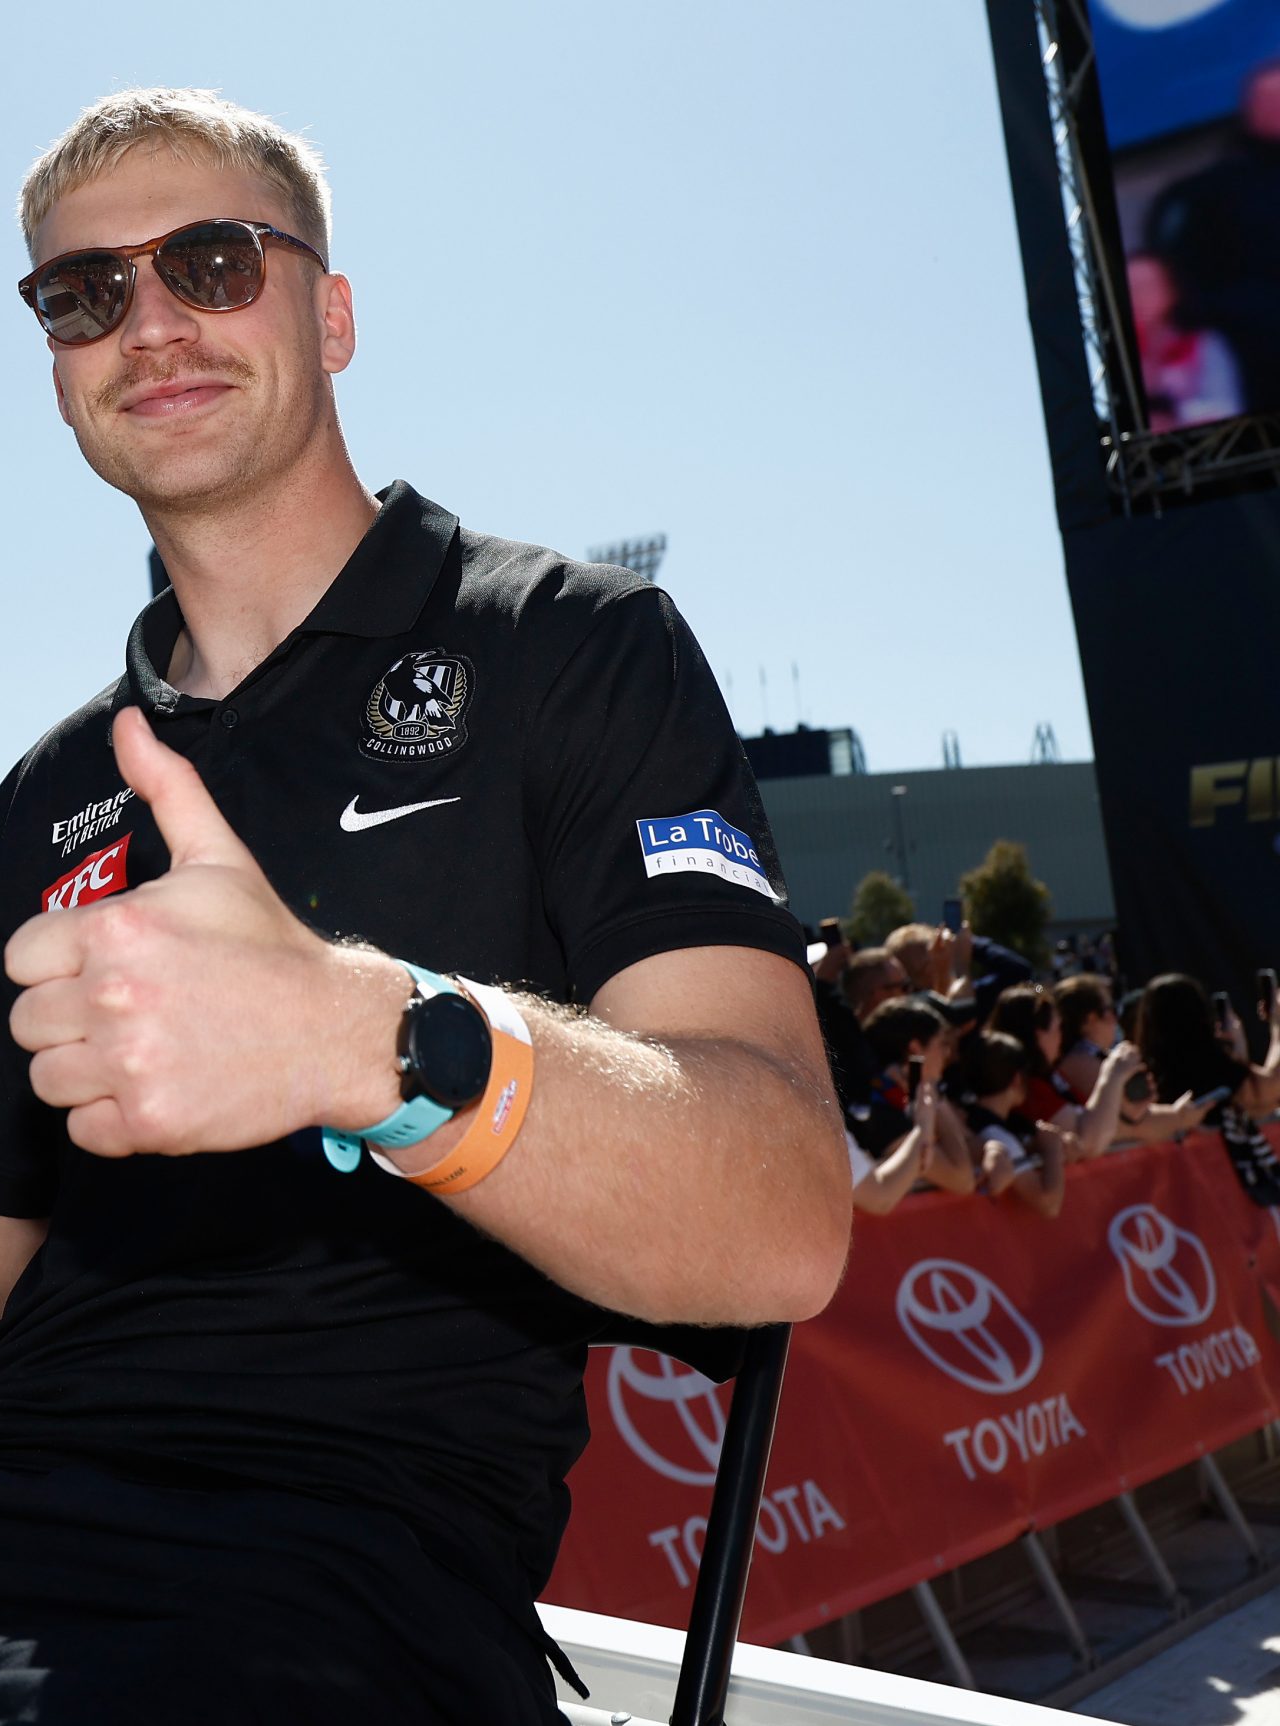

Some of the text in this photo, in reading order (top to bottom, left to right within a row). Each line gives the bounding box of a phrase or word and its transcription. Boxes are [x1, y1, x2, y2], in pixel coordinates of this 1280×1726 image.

[366, 736, 453, 756] COLLINGWOOD
[400, 726, 421, 737] 1892
[1189, 756, 1280, 828] FI
[61, 806, 124, 858] FLY BETTER
[647, 817, 761, 868] La Trobe
[47, 845, 122, 913] KFC
[656, 856, 770, 893] financial
[1154, 1326, 1261, 1396] TOYOTA
[943, 1393, 1087, 1481] TOYOTA
[649, 1479, 847, 1589] TOOTA
